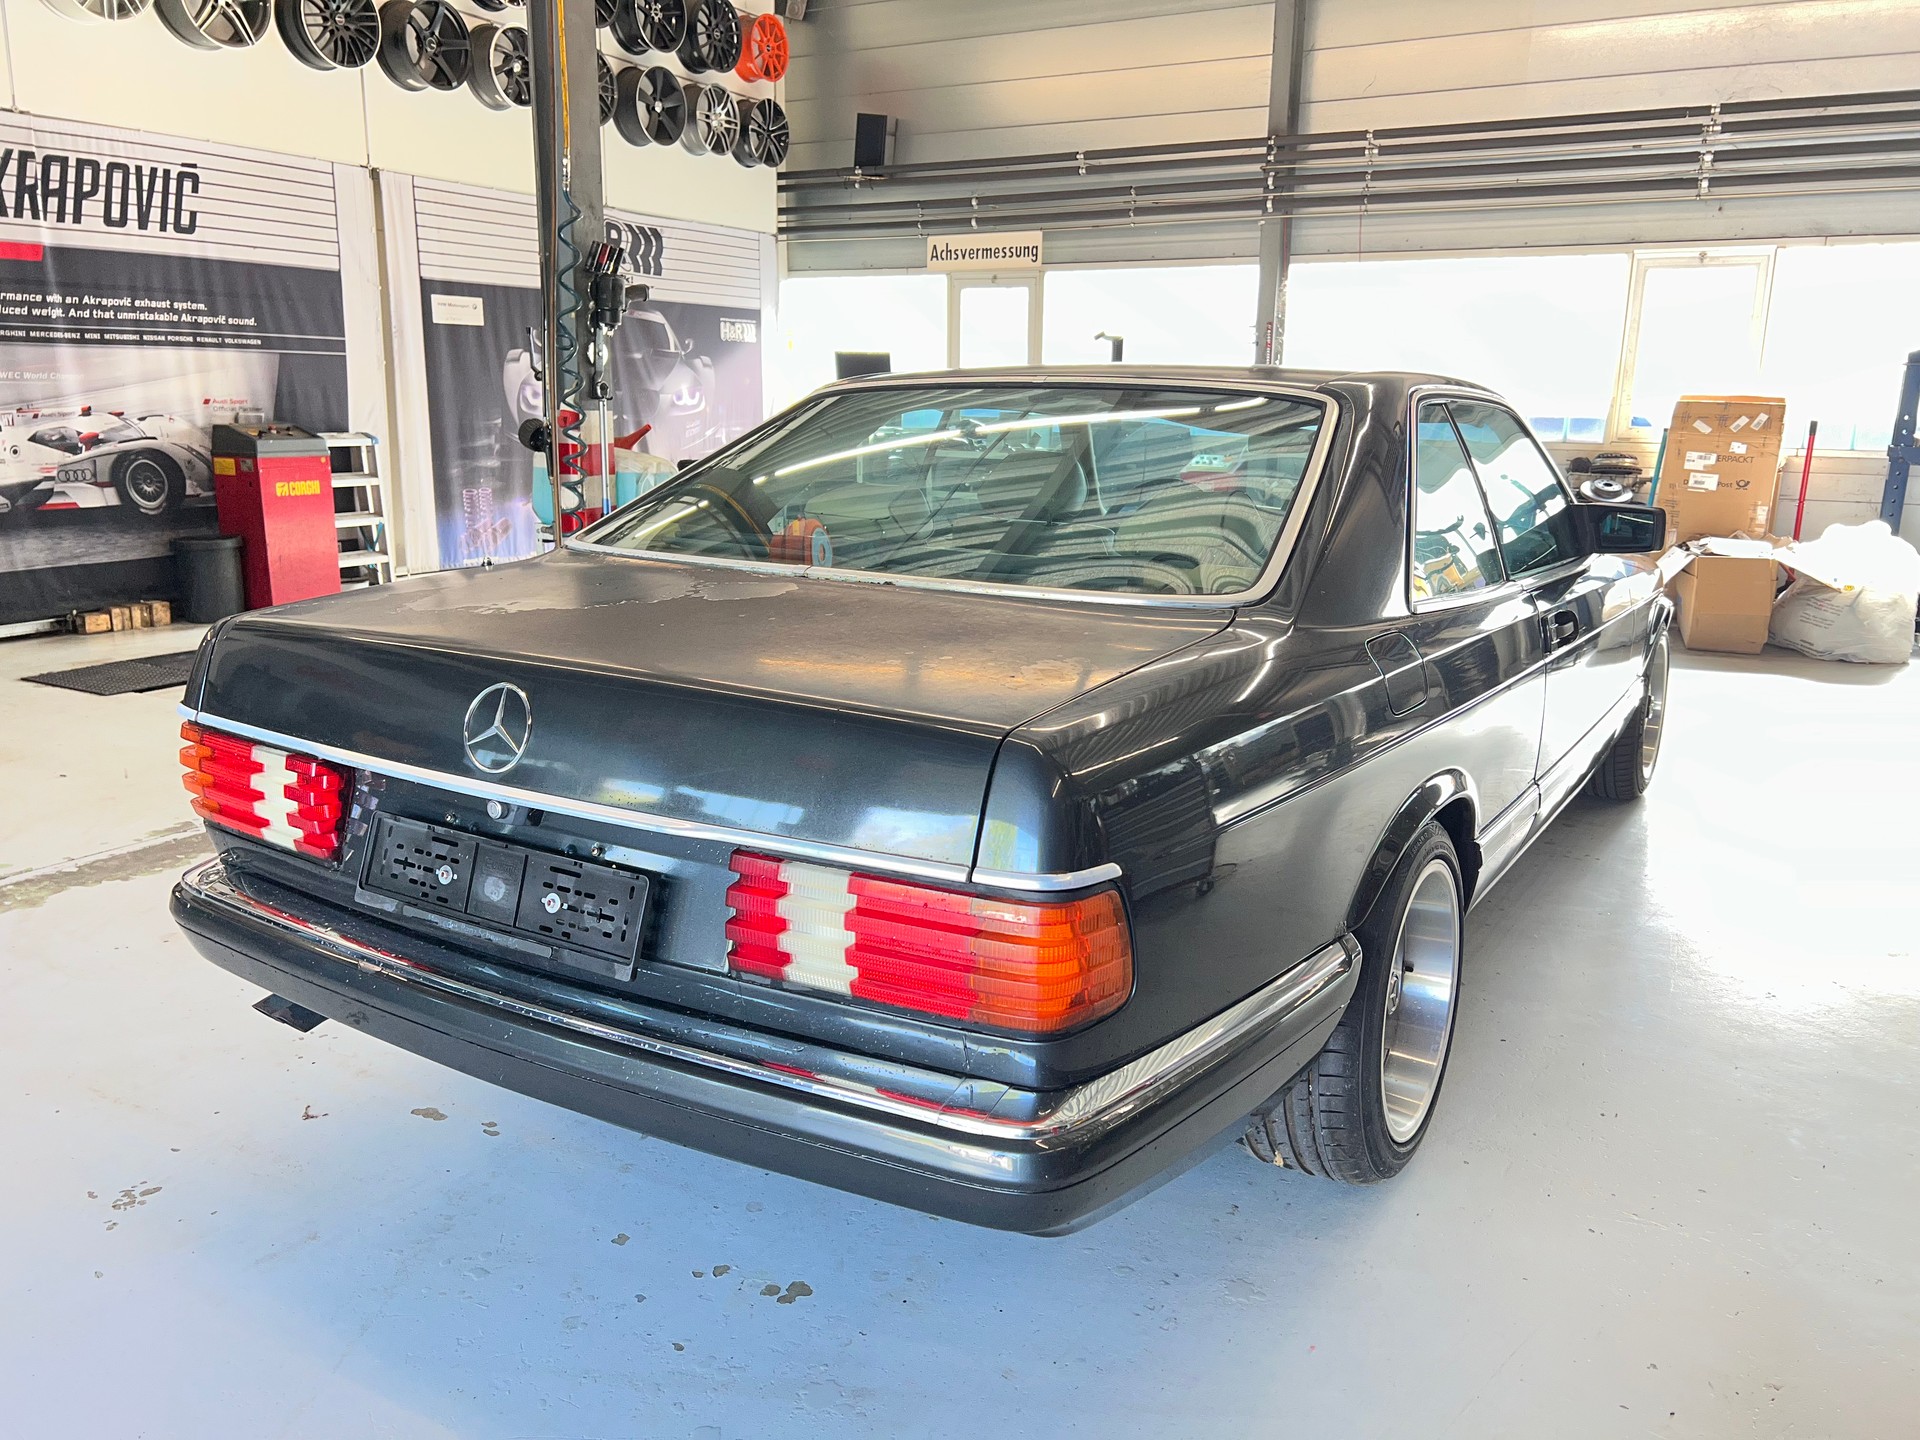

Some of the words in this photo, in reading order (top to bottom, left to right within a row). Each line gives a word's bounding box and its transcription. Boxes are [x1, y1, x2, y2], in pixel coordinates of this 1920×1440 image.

[930, 242, 1039, 262] Achsvermessung
[65, 295, 79, 304] an
[82, 295, 132, 307] Akrapovič
[134, 298, 171, 308] exhaust
[173, 300, 208, 311] system.
[68, 308, 90, 318] And
[92, 309, 115, 319] that
[117, 310, 179, 321] unmistakable
[181, 313, 226, 325] Akrapovič
[227, 317, 257, 326] sound.
[142, 334, 166, 342] NISSAN
[167, 335, 194, 343] PORSCHE
[196, 336, 222, 344] RENAULT
[224, 337, 262, 345] VOLKSWAGEN
[23, 371, 48, 380] World
[230, 398, 248, 406] Sport
[1718, 455, 1755, 464] ERPACKT
[289, 480, 321, 496] CORGHI
